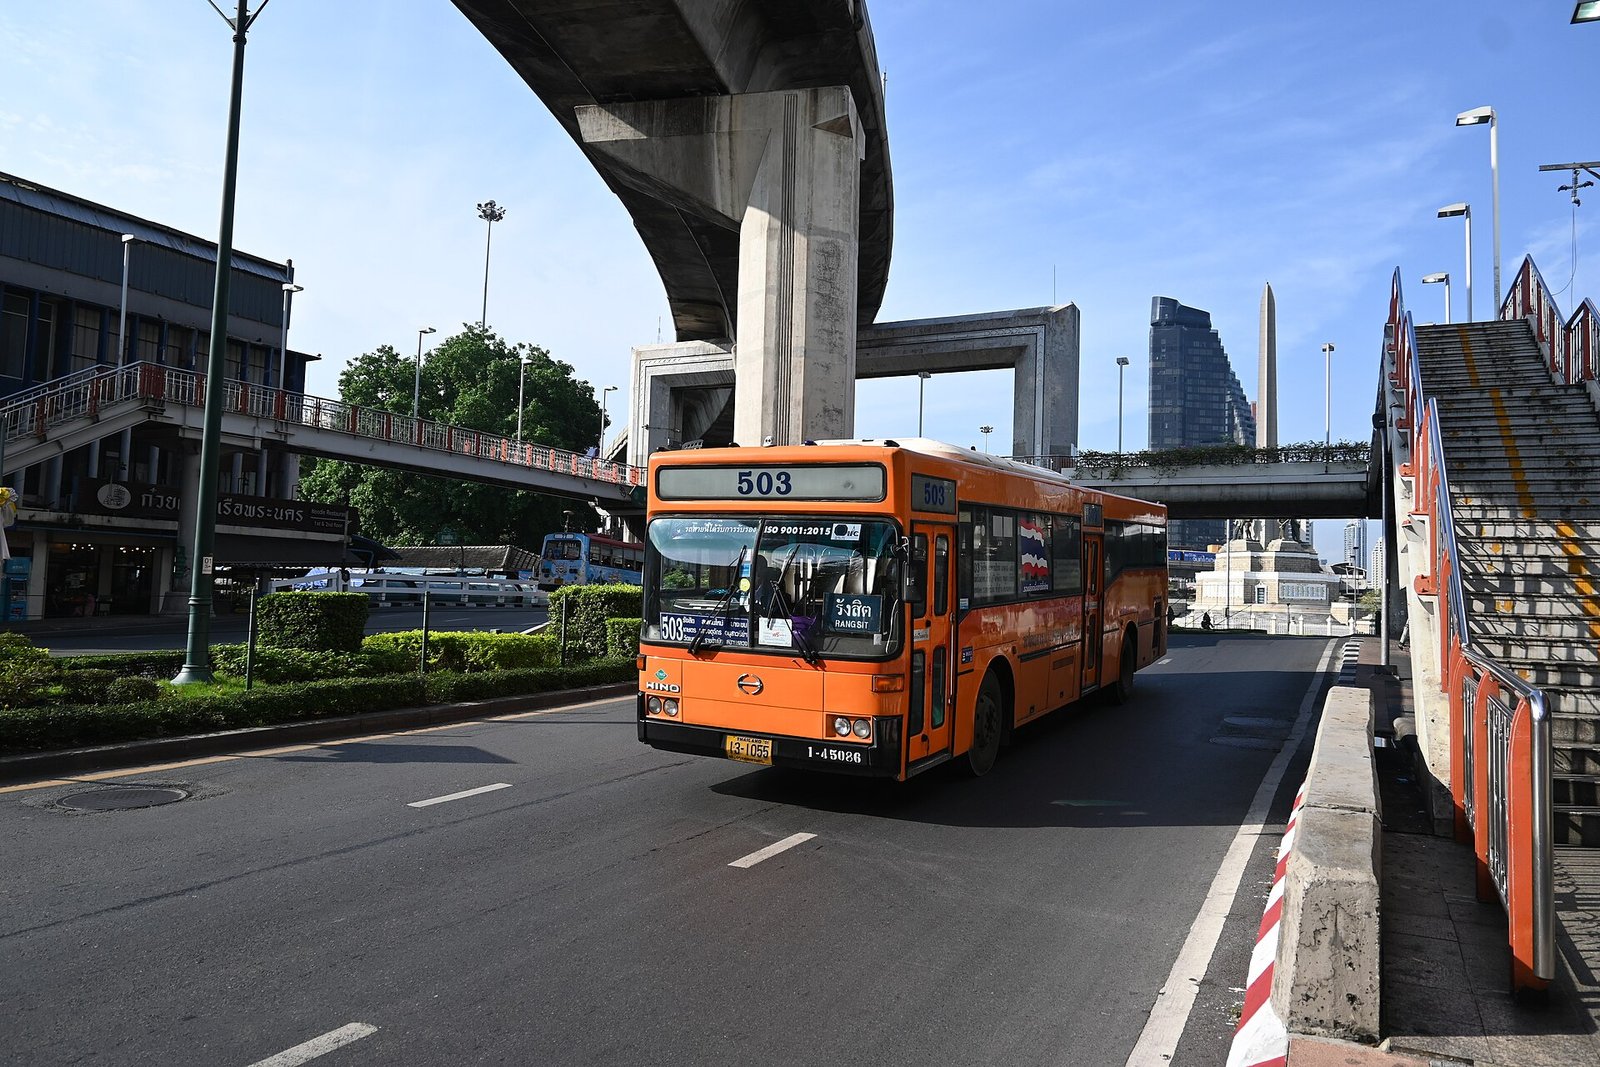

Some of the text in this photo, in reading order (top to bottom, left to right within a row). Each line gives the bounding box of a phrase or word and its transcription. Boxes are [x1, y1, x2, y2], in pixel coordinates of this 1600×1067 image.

[737, 471, 792, 496] 503
[924, 483, 945, 506] 503
[763, 525, 832, 535] ISO 9001:2015
[835, 597, 872, 618] รังสิต
[662, 615, 683, 641] 503
[835, 619, 869, 630] RANGSIT
[646, 681, 680, 693] HINO
[730, 741, 769, 758] 13-1055
[807, 746, 862, 764] 1-45086
